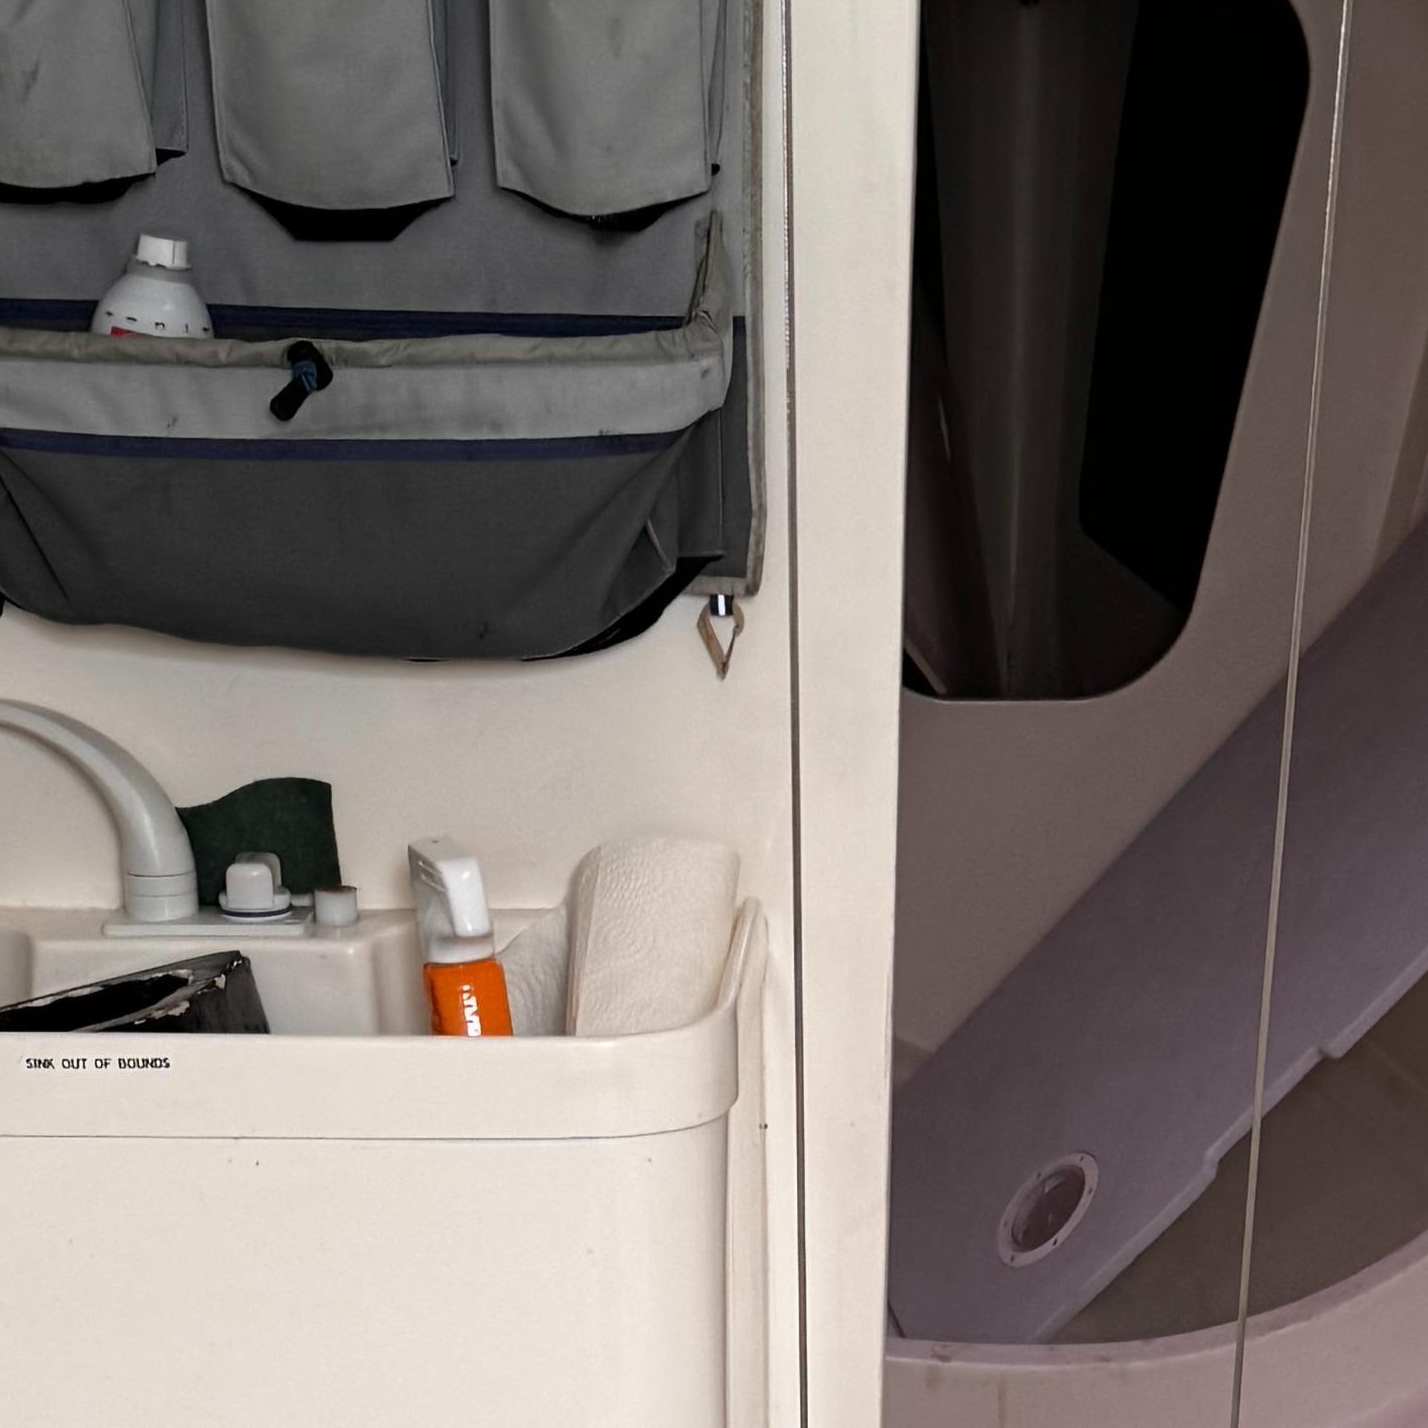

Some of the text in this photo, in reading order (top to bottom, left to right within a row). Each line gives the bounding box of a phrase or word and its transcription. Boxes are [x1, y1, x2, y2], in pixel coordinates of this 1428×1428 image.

[25, 1057, 171, 1069] SINK OUT OF BOUNDS
